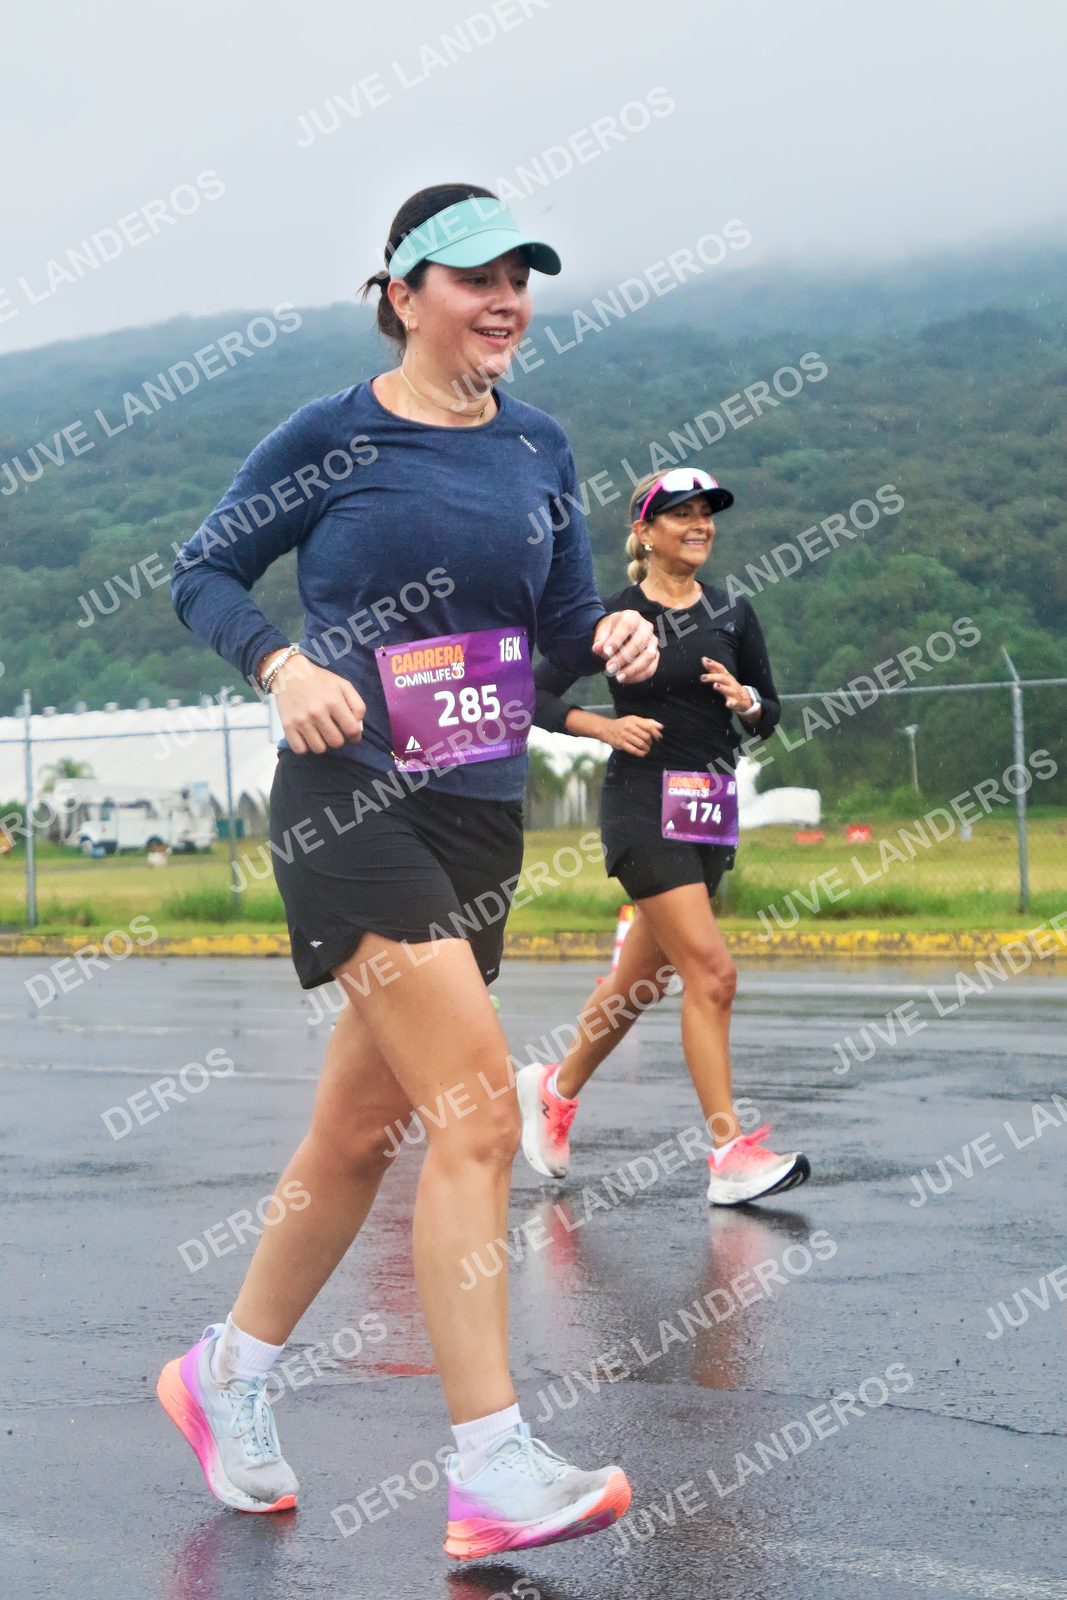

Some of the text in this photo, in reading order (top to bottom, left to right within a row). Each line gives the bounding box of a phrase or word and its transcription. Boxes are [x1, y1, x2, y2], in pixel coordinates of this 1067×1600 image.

[391, 644, 465, 674] CARRERA
[499, 636, 522, 662] 15K
[434, 684, 501, 727] 285
[687, 801, 722, 824] 174
